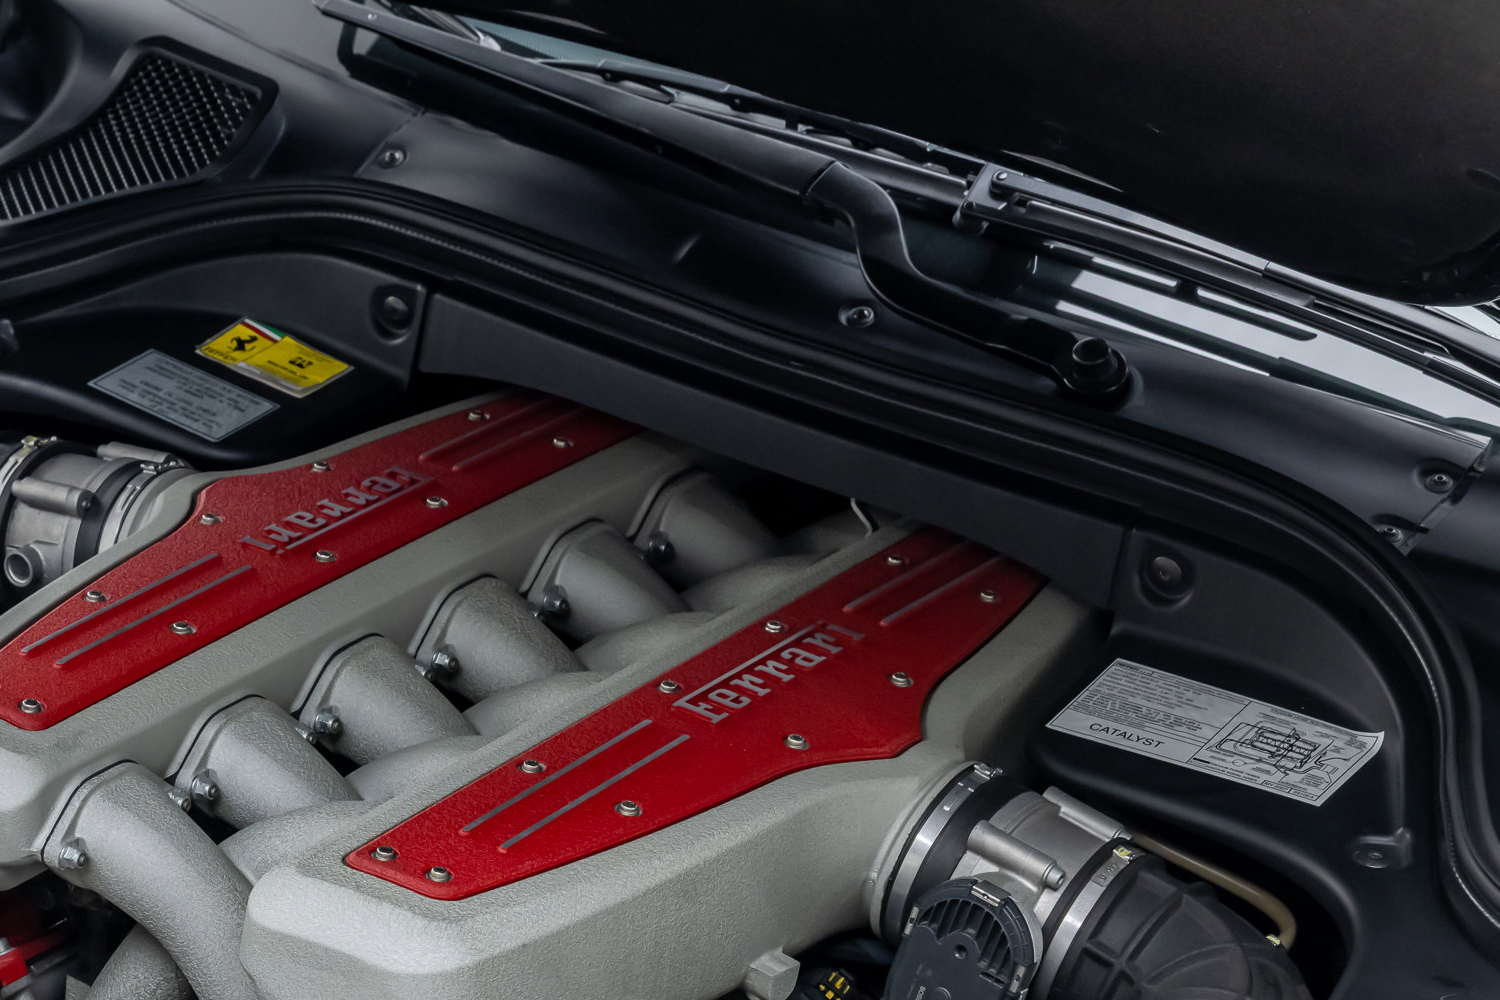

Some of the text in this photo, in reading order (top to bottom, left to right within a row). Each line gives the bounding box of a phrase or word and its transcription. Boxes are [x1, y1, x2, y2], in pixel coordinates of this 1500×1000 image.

[239, 465, 436, 556] Ferrari
[673, 621, 866, 725] Ferrari
[1087, 722, 1165, 749] CATALYST
